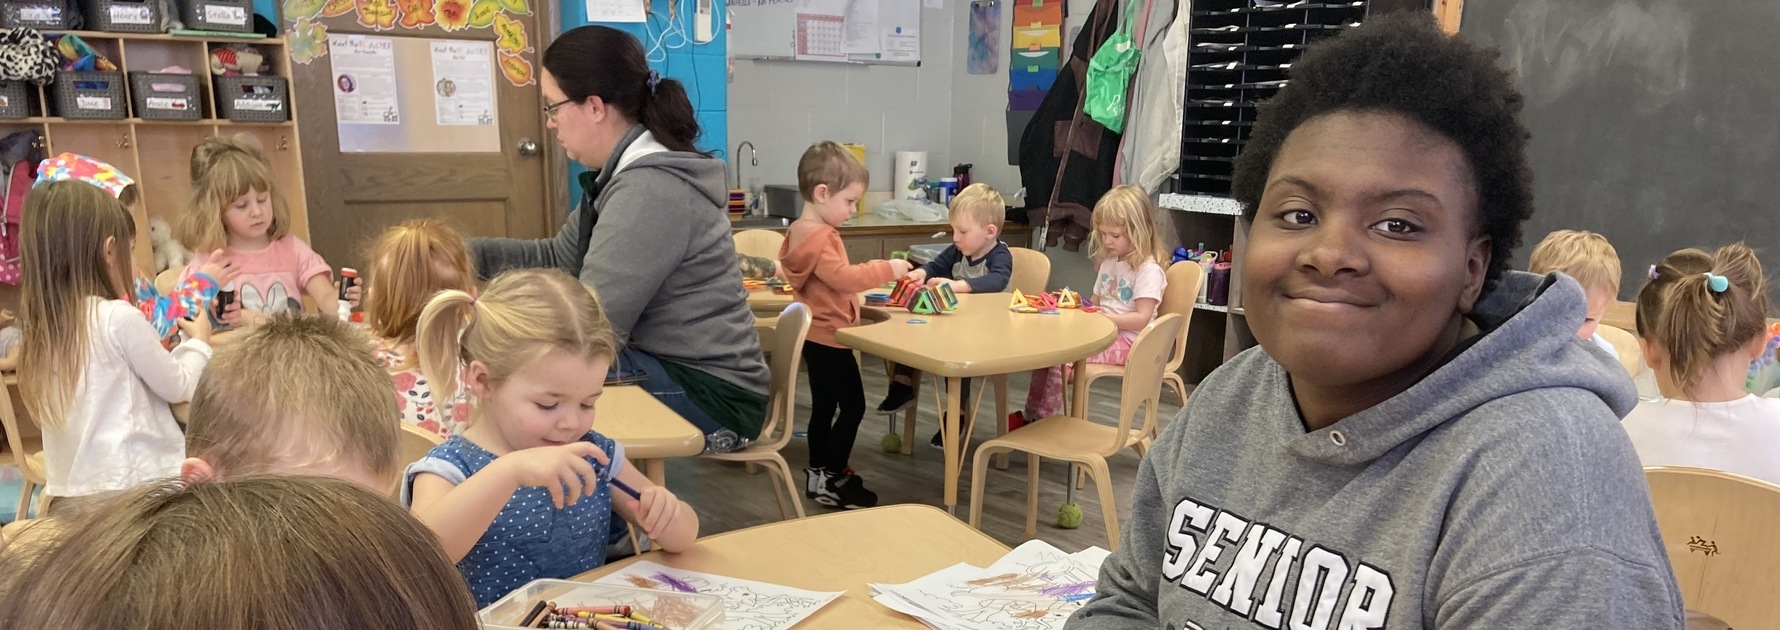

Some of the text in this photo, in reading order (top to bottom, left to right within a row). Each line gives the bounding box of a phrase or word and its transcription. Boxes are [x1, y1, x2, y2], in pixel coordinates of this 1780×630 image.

[113, 10, 138, 21] Henry
[207, 9, 231, 19] Stella
[1161, 497, 1396, 630] SENIOR
